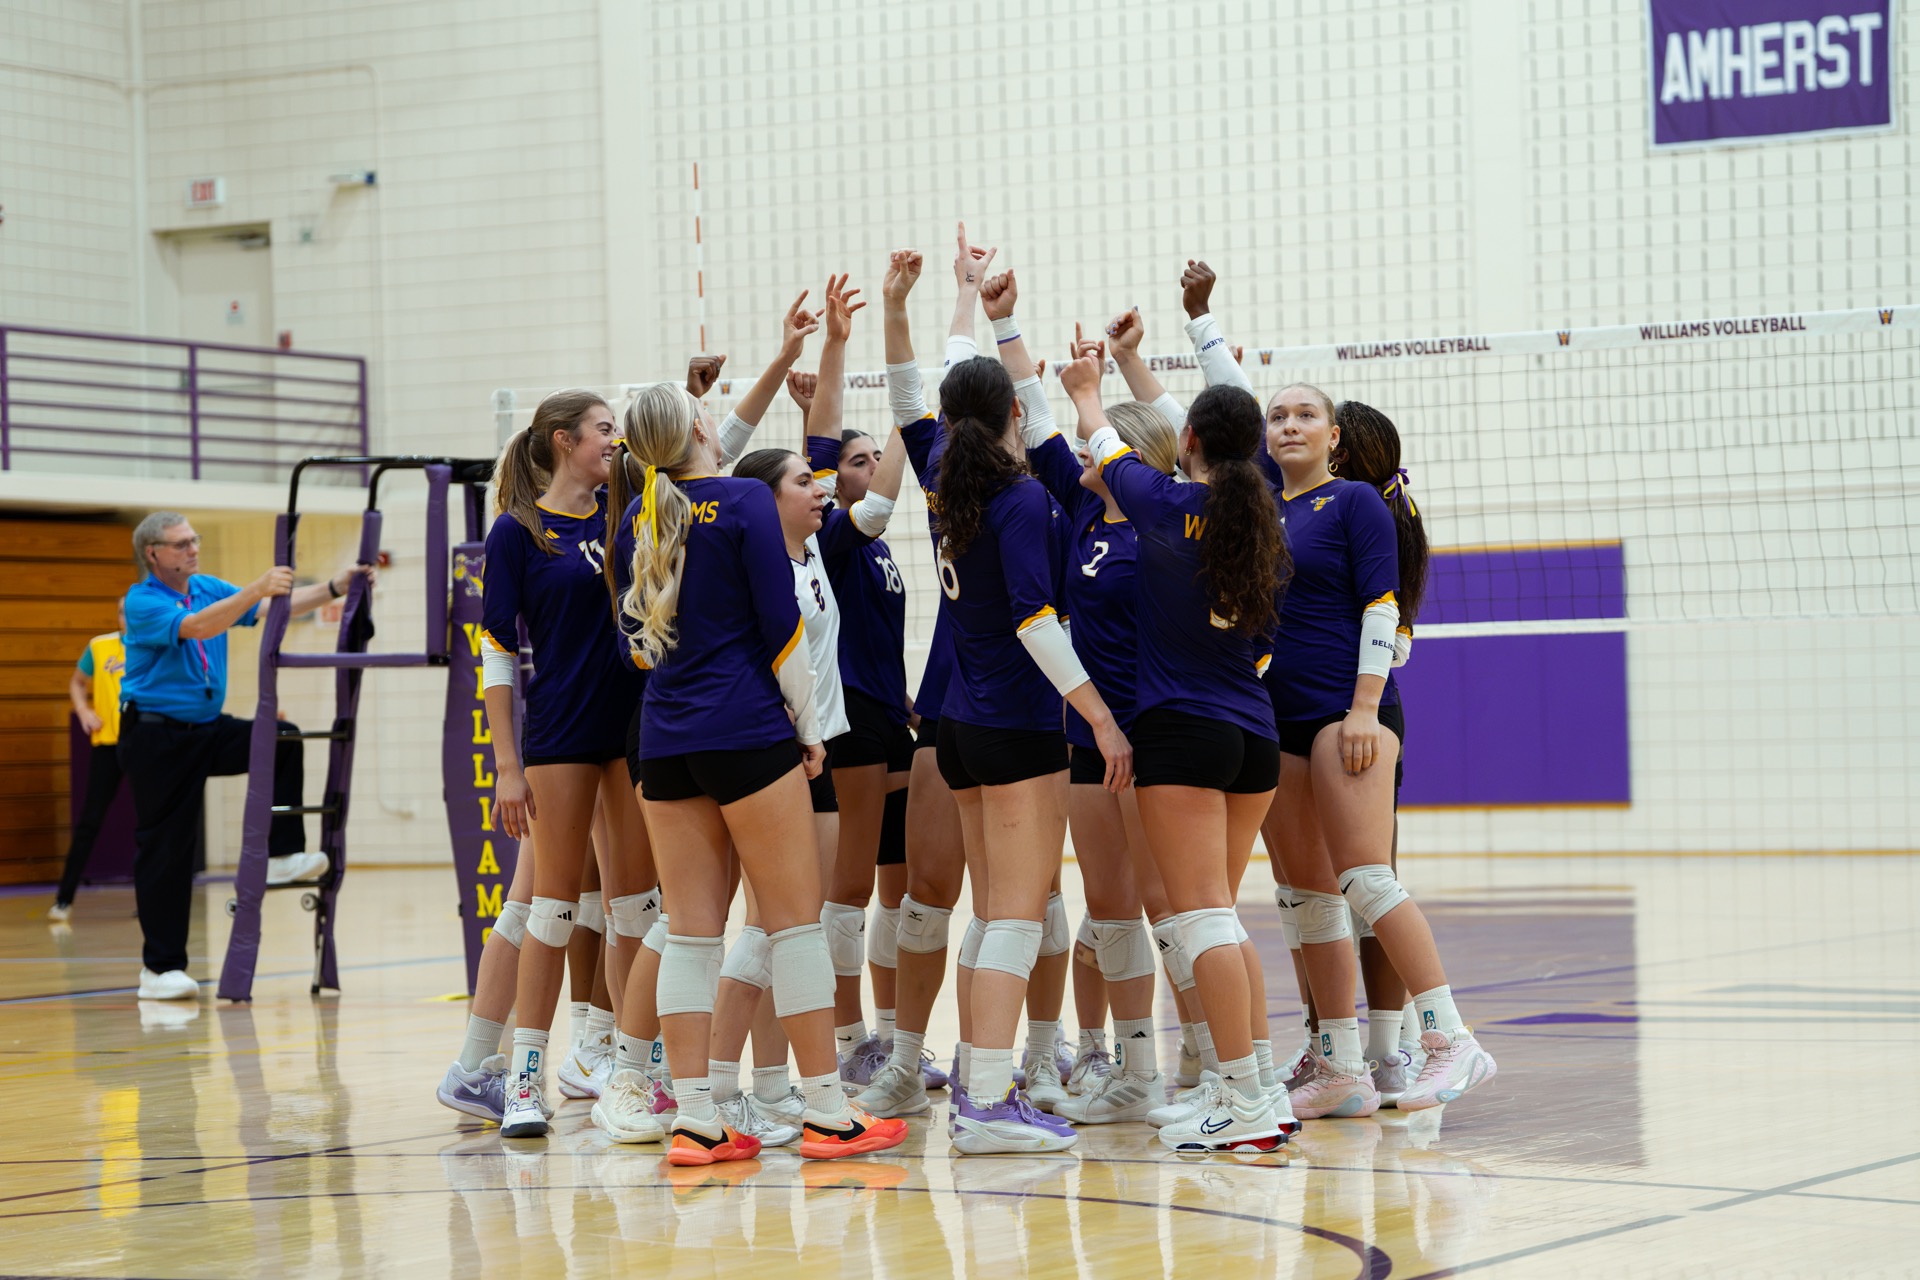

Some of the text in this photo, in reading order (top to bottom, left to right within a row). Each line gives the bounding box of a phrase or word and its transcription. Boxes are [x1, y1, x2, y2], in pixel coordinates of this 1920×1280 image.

[1661, 12, 1883, 104] AMHERST
[1639, 316, 1807, 340] WILLIAMS VOLLEYBALL
[1336, 336, 1491, 360] WILLIAMS VOLLEYBALL
[1146, 355, 1198, 371] EYBALL
[848, 374, 889, 389] VOLLE
[1081, 541, 1110, 578] 2
[874, 555, 903, 595] 18
